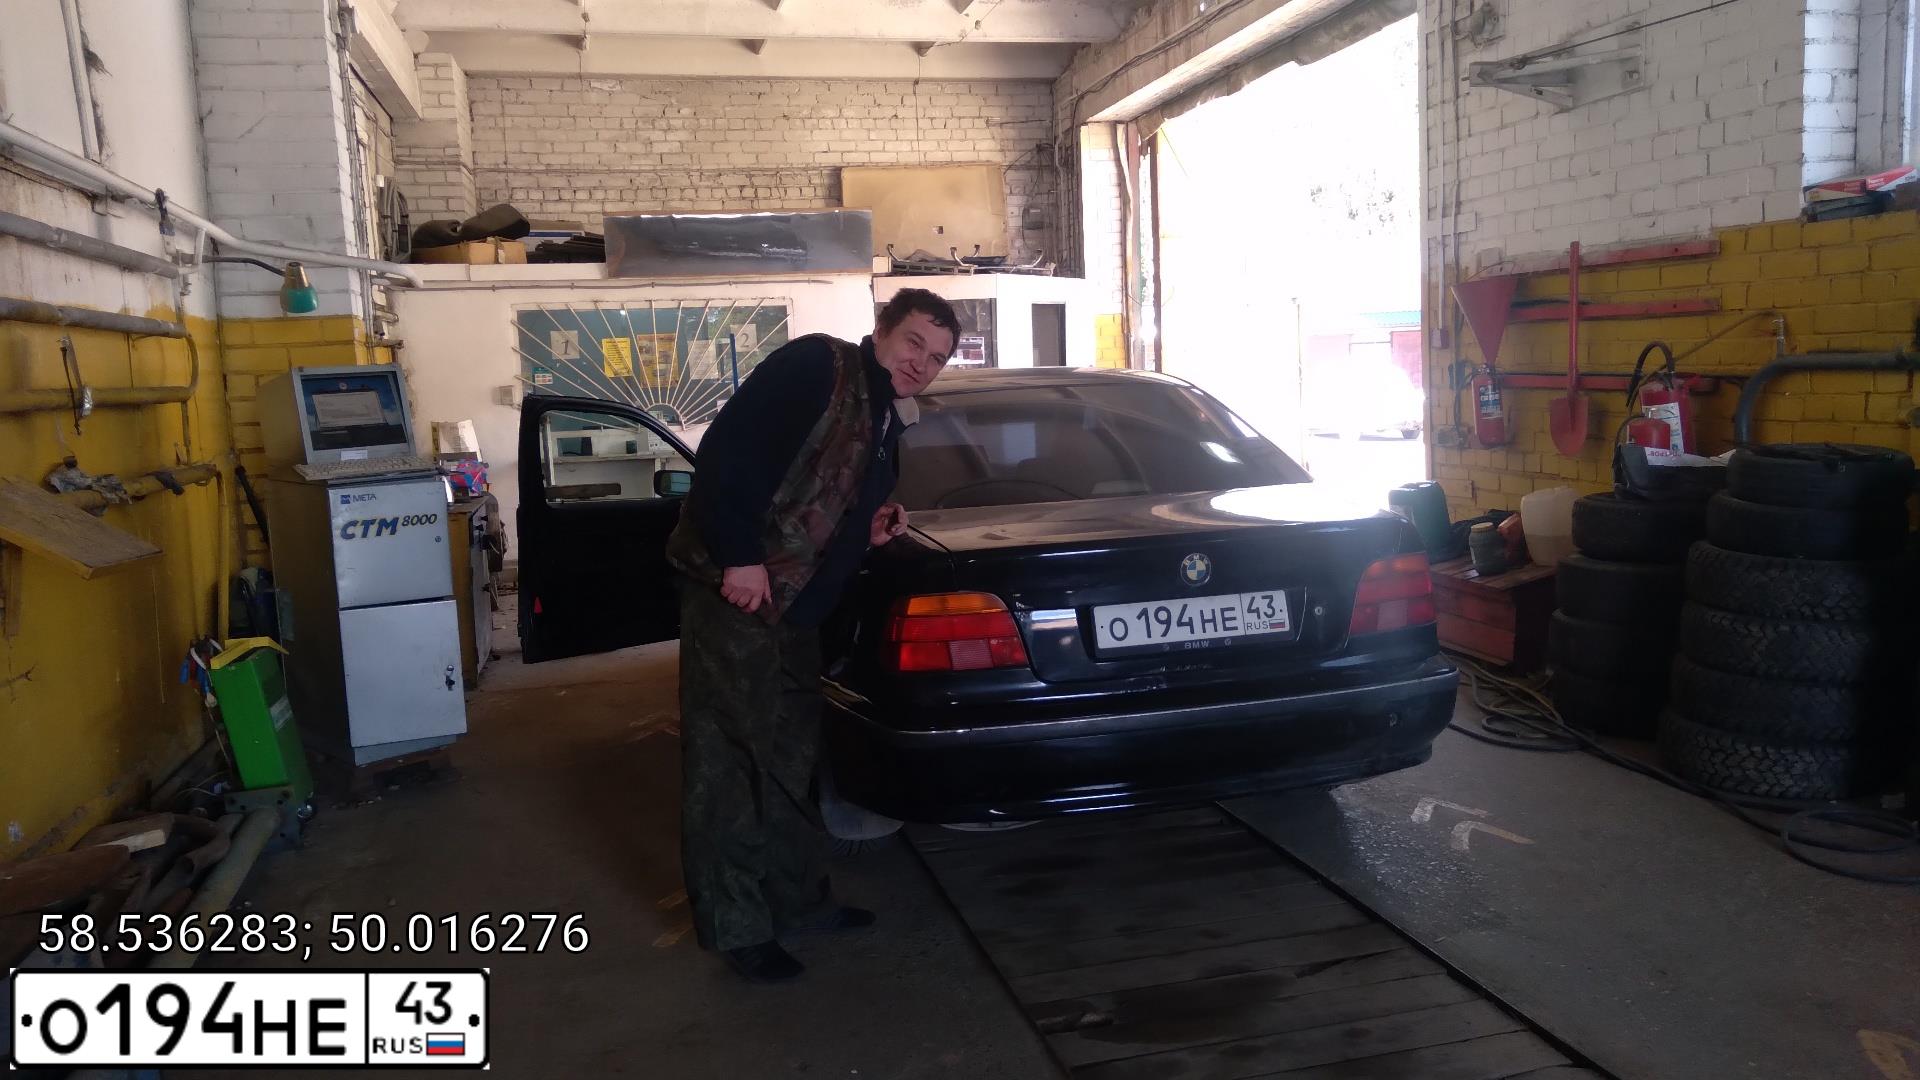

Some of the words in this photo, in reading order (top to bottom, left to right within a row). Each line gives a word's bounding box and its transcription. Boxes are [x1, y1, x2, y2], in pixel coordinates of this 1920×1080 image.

[561, 340, 571, 355] 1
[740, 333, 749, 348] 2
[401, 513, 438, 527] 8000
[1247, 594, 1276, 619] 43
[1246, 620, 1269, 630] RUS
[1184, 640, 1210, 649] BMW
